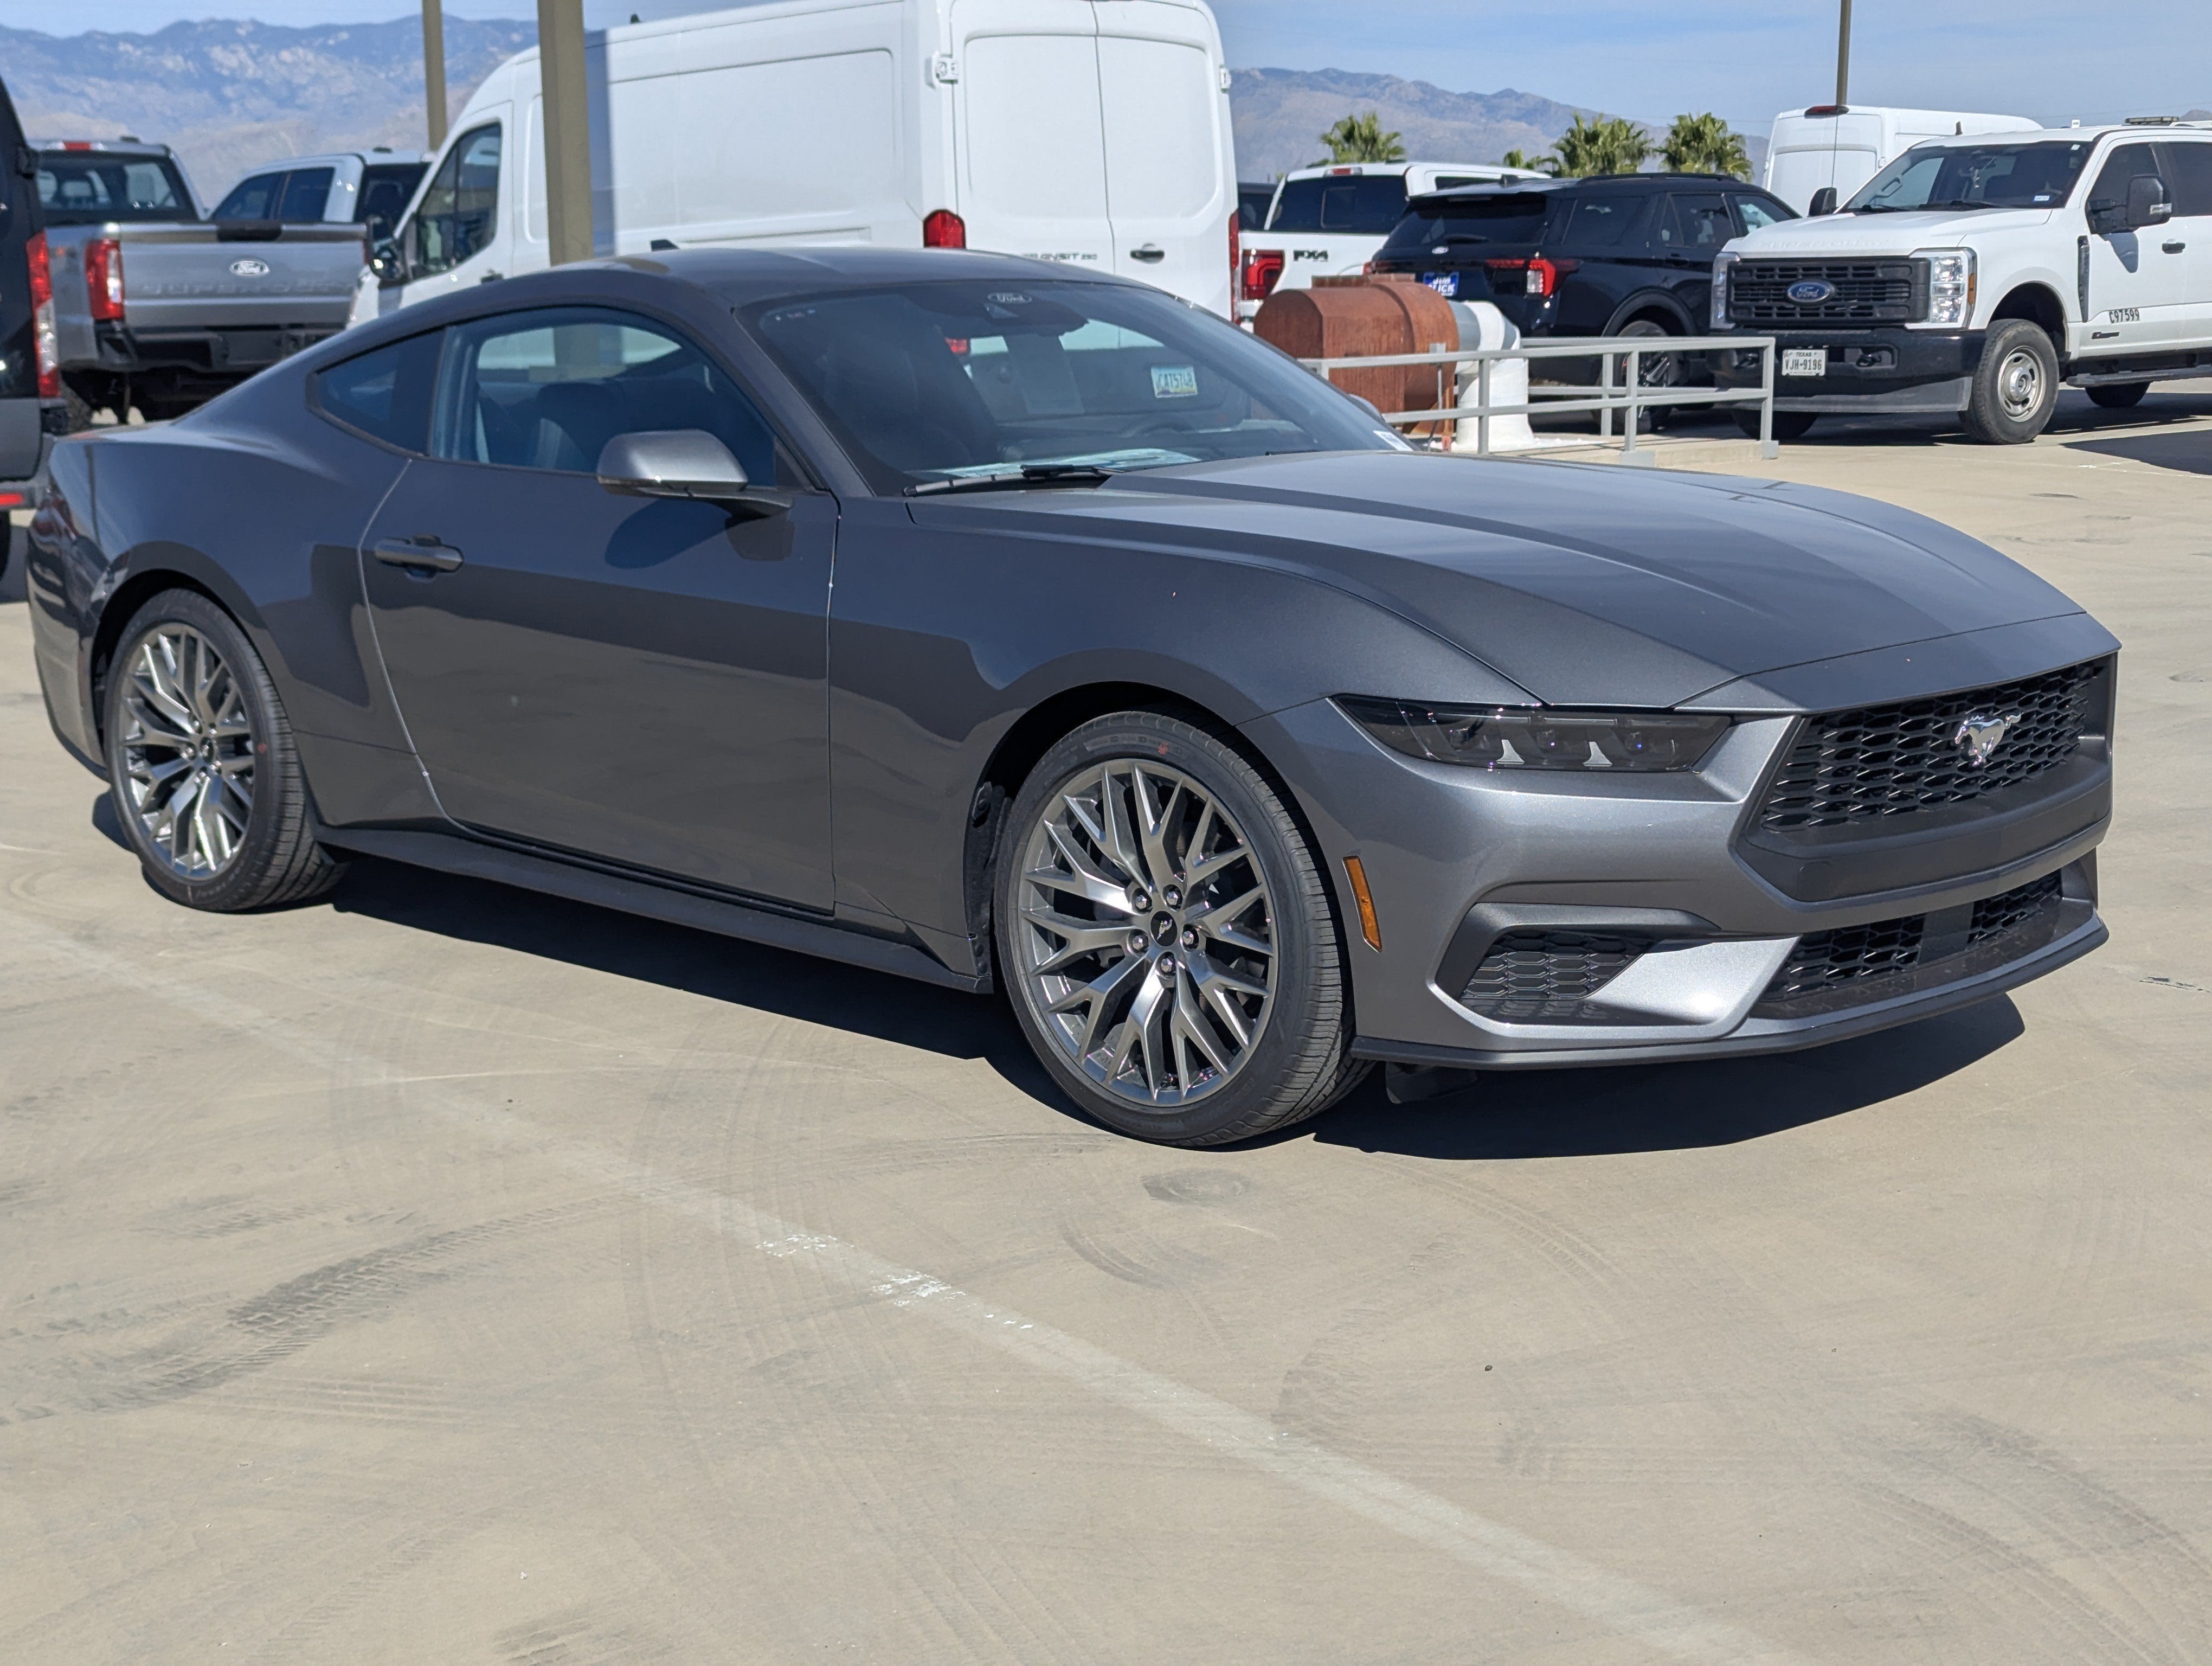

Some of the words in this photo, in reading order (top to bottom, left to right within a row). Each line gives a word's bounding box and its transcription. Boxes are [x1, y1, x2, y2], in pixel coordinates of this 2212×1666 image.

[1293, 250, 1328, 261] FX4
[1797, 286, 1819, 298] Ford
[2109, 309, 2140, 324] C97599
